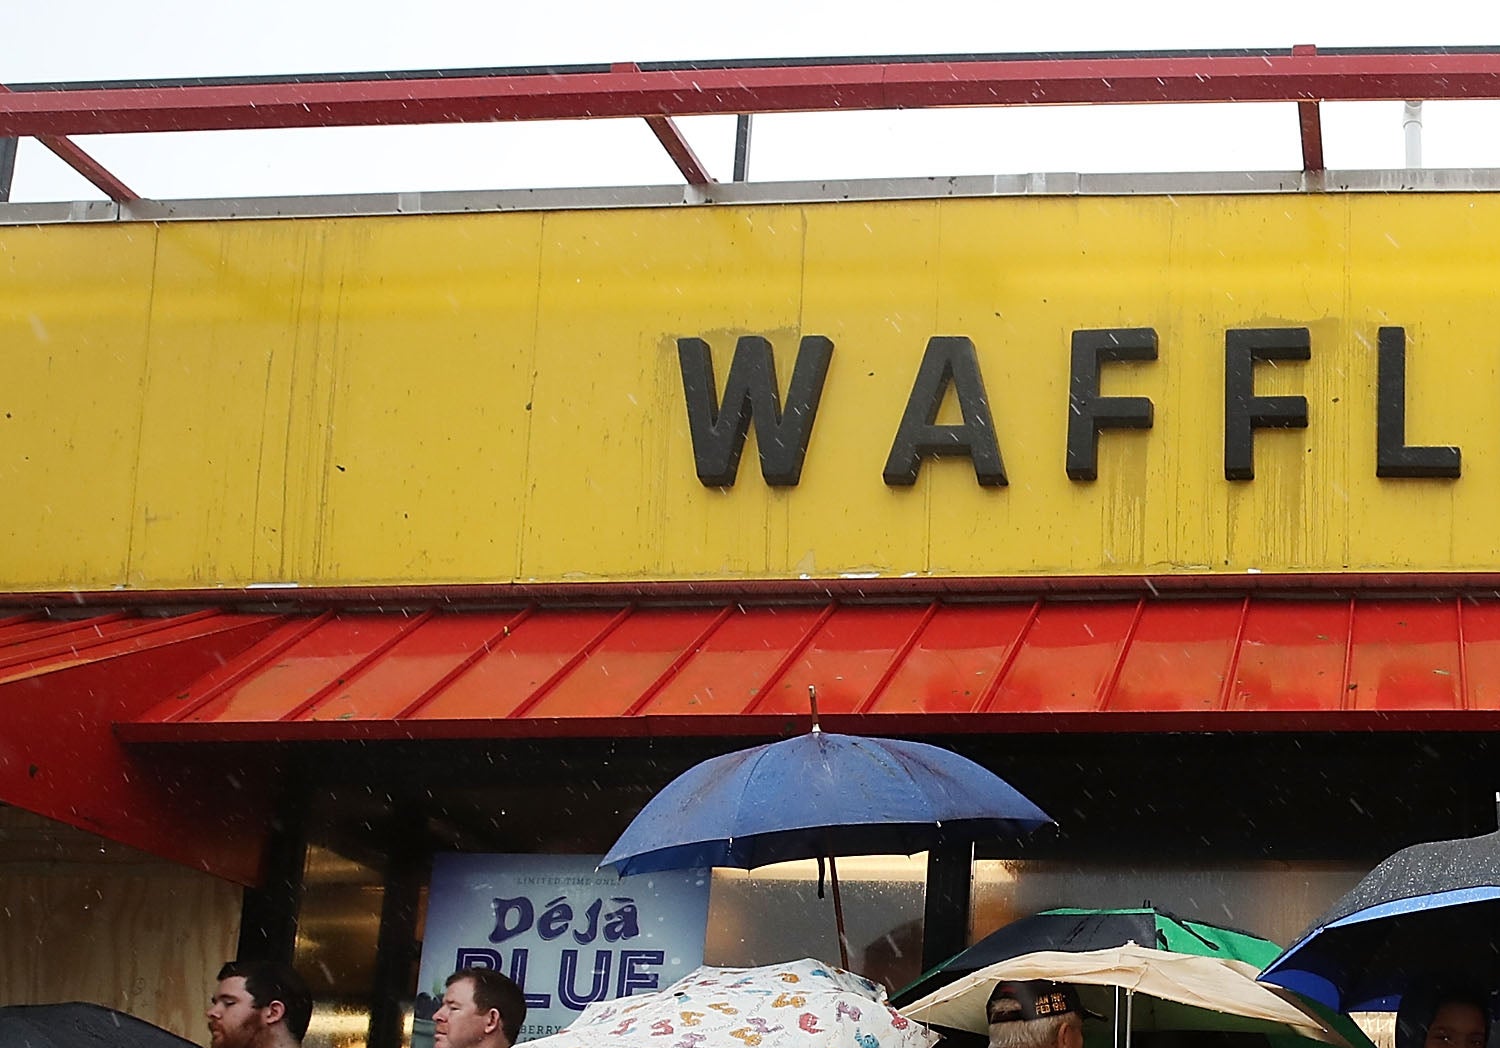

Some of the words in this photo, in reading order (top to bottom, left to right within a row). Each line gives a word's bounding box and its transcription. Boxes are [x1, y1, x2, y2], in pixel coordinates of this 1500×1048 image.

[517, 876, 561, 886] LIMITED
[565, 876, 592, 886] TIME
[1035, 994, 1049, 1005] JAN
[1035, 1004, 1051, 1015] FEB
